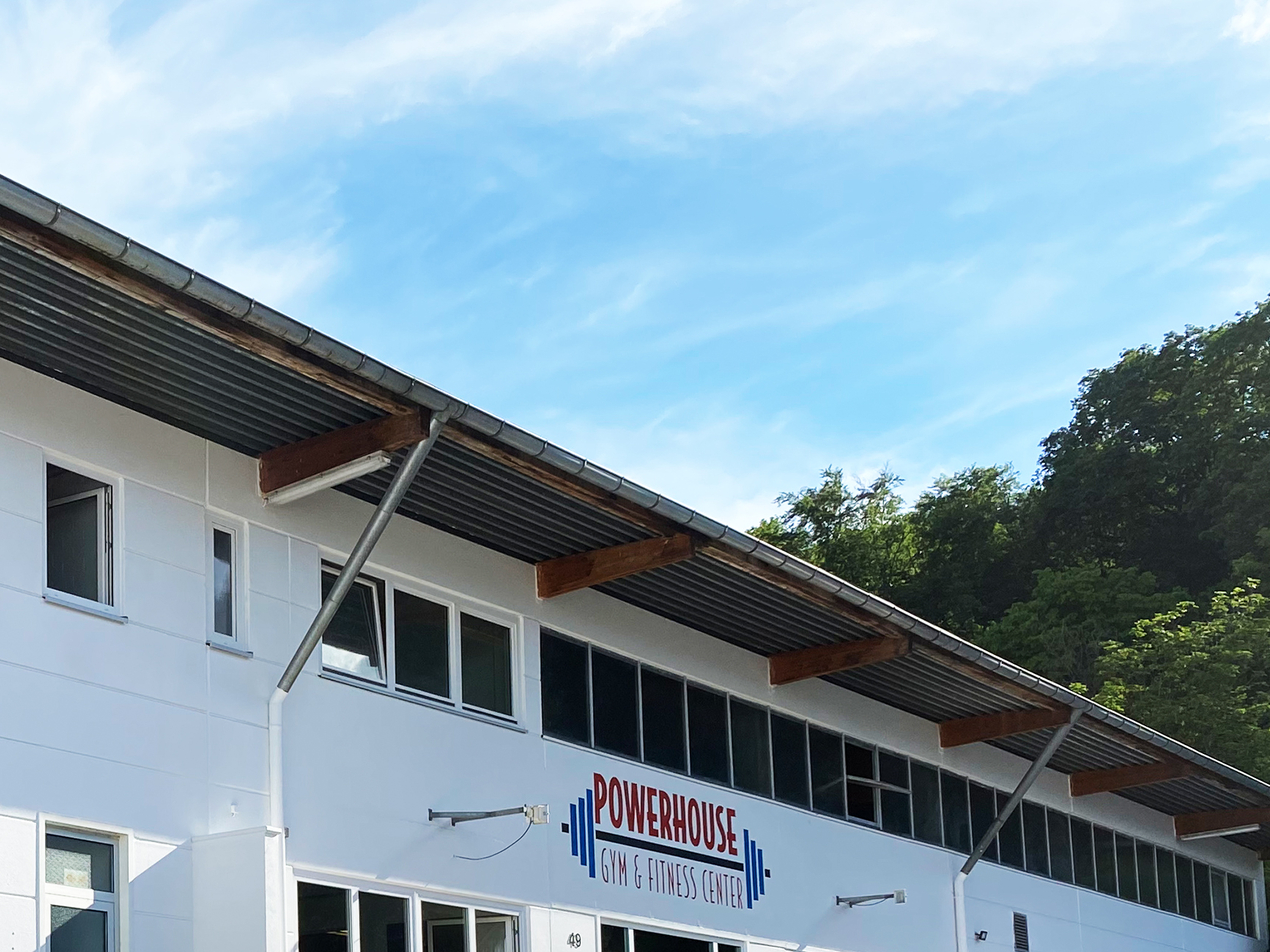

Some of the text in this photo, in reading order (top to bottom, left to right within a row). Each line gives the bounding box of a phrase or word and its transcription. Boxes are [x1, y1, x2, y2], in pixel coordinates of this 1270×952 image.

[593, 773, 738, 856] POWERHOUSE
[601, 847, 744, 910] GYM & FITNESS CENTER
[567, 932, 582, 949] 49
